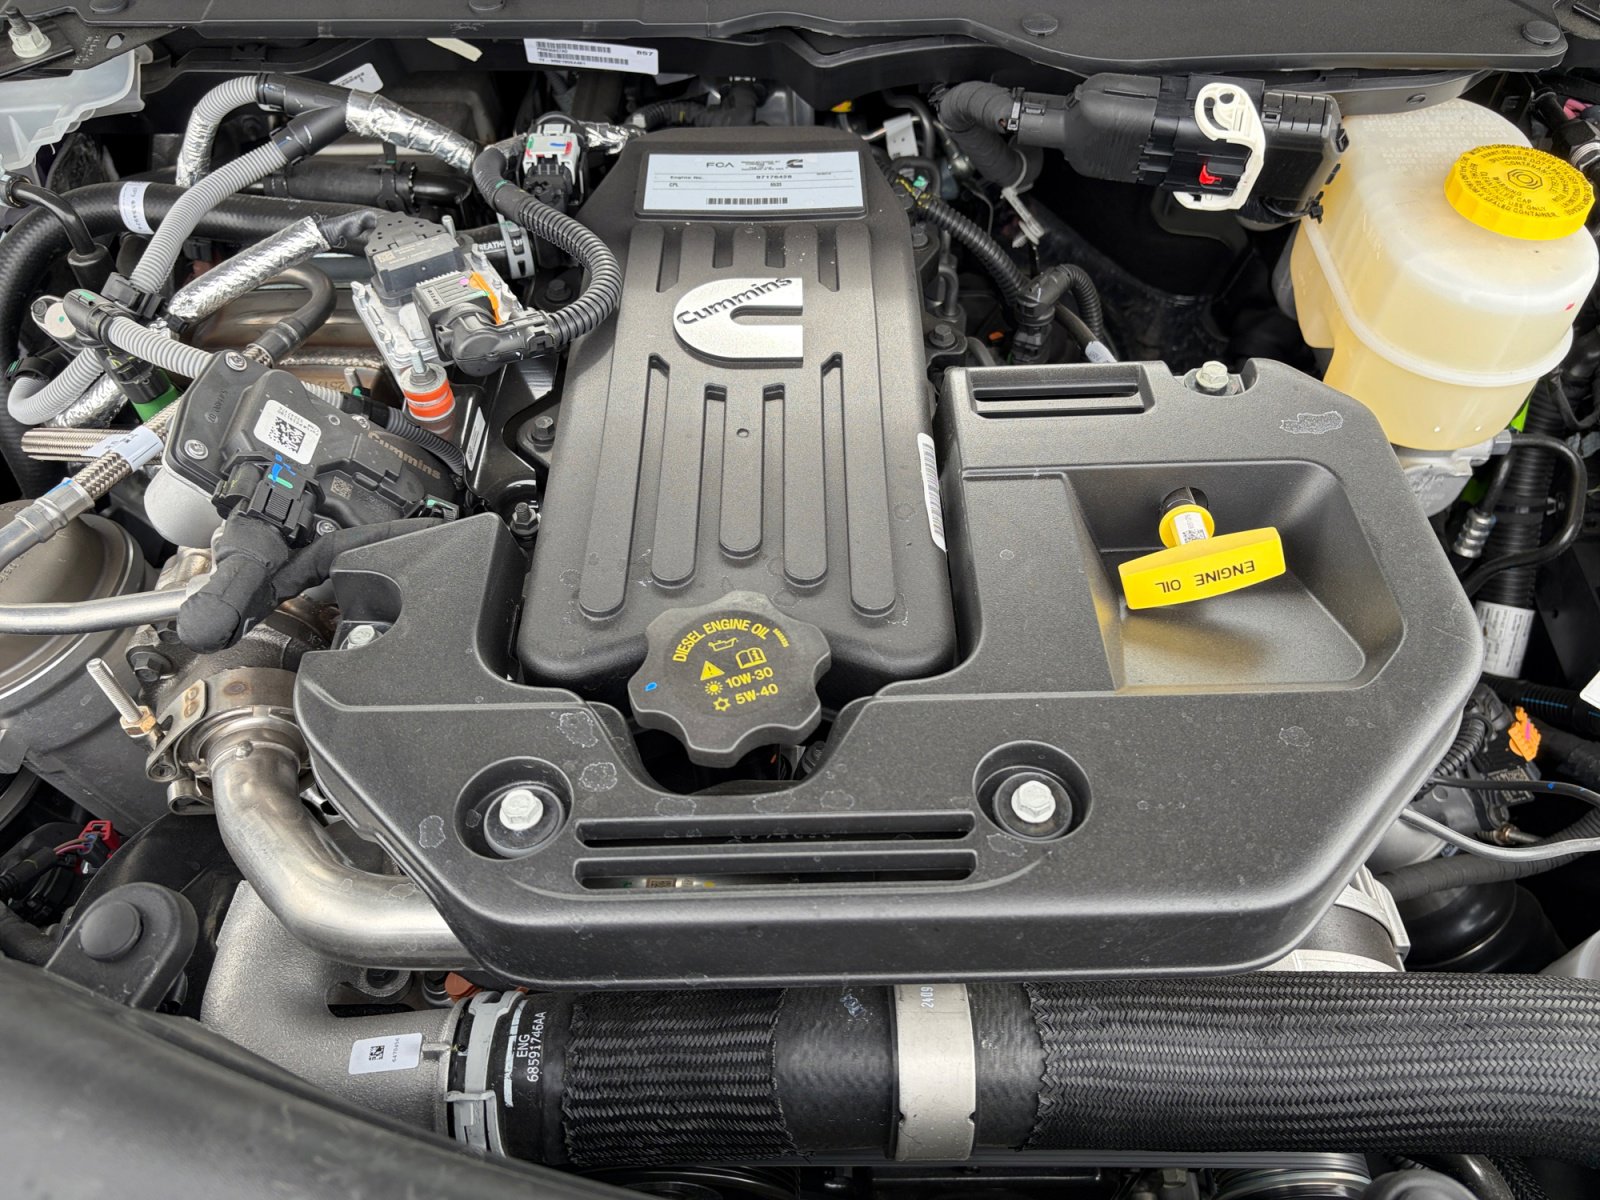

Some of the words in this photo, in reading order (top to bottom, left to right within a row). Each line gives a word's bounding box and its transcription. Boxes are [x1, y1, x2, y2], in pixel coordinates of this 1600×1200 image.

[706, 161, 735, 169] FCA
[676, 278, 793, 325] Cummins
[367, 431, 441, 480] Cummins
[1154, 579, 1183, 594] OIL
[1193, 560, 1256, 587] ENGINE
[672, 629, 706, 662] DIESEL
[702, 618, 752, 635] ENGINE
[750, 623, 770, 640] OIL
[725, 666, 774, 689] 10W-30
[735, 682, 779, 705] 5W-40
[516, 1033, 531, 1058] ENG
[526, 1010, 547, 1083] 68591746AA
